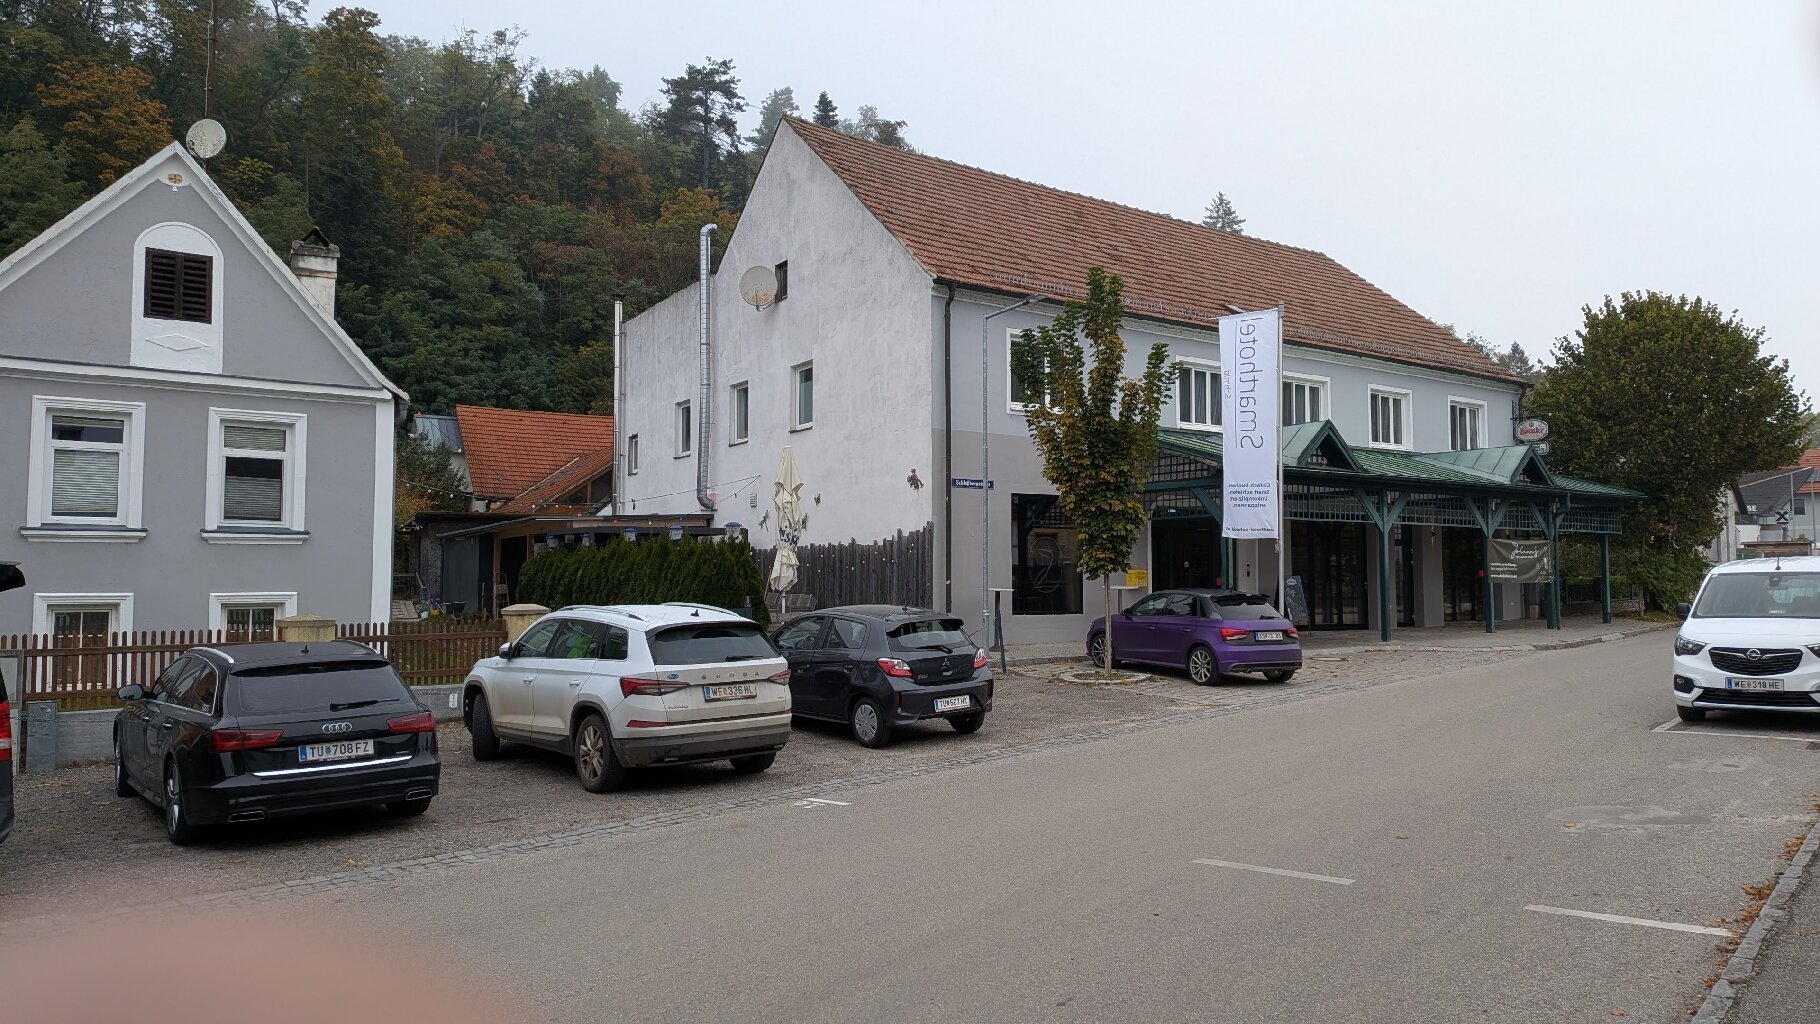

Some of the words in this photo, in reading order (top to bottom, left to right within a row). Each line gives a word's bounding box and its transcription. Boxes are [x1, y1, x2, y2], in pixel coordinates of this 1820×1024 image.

[309, 746, 324, 758] TU
[332, 743, 354, 756] 708
[355, 741, 370, 753] FZ
